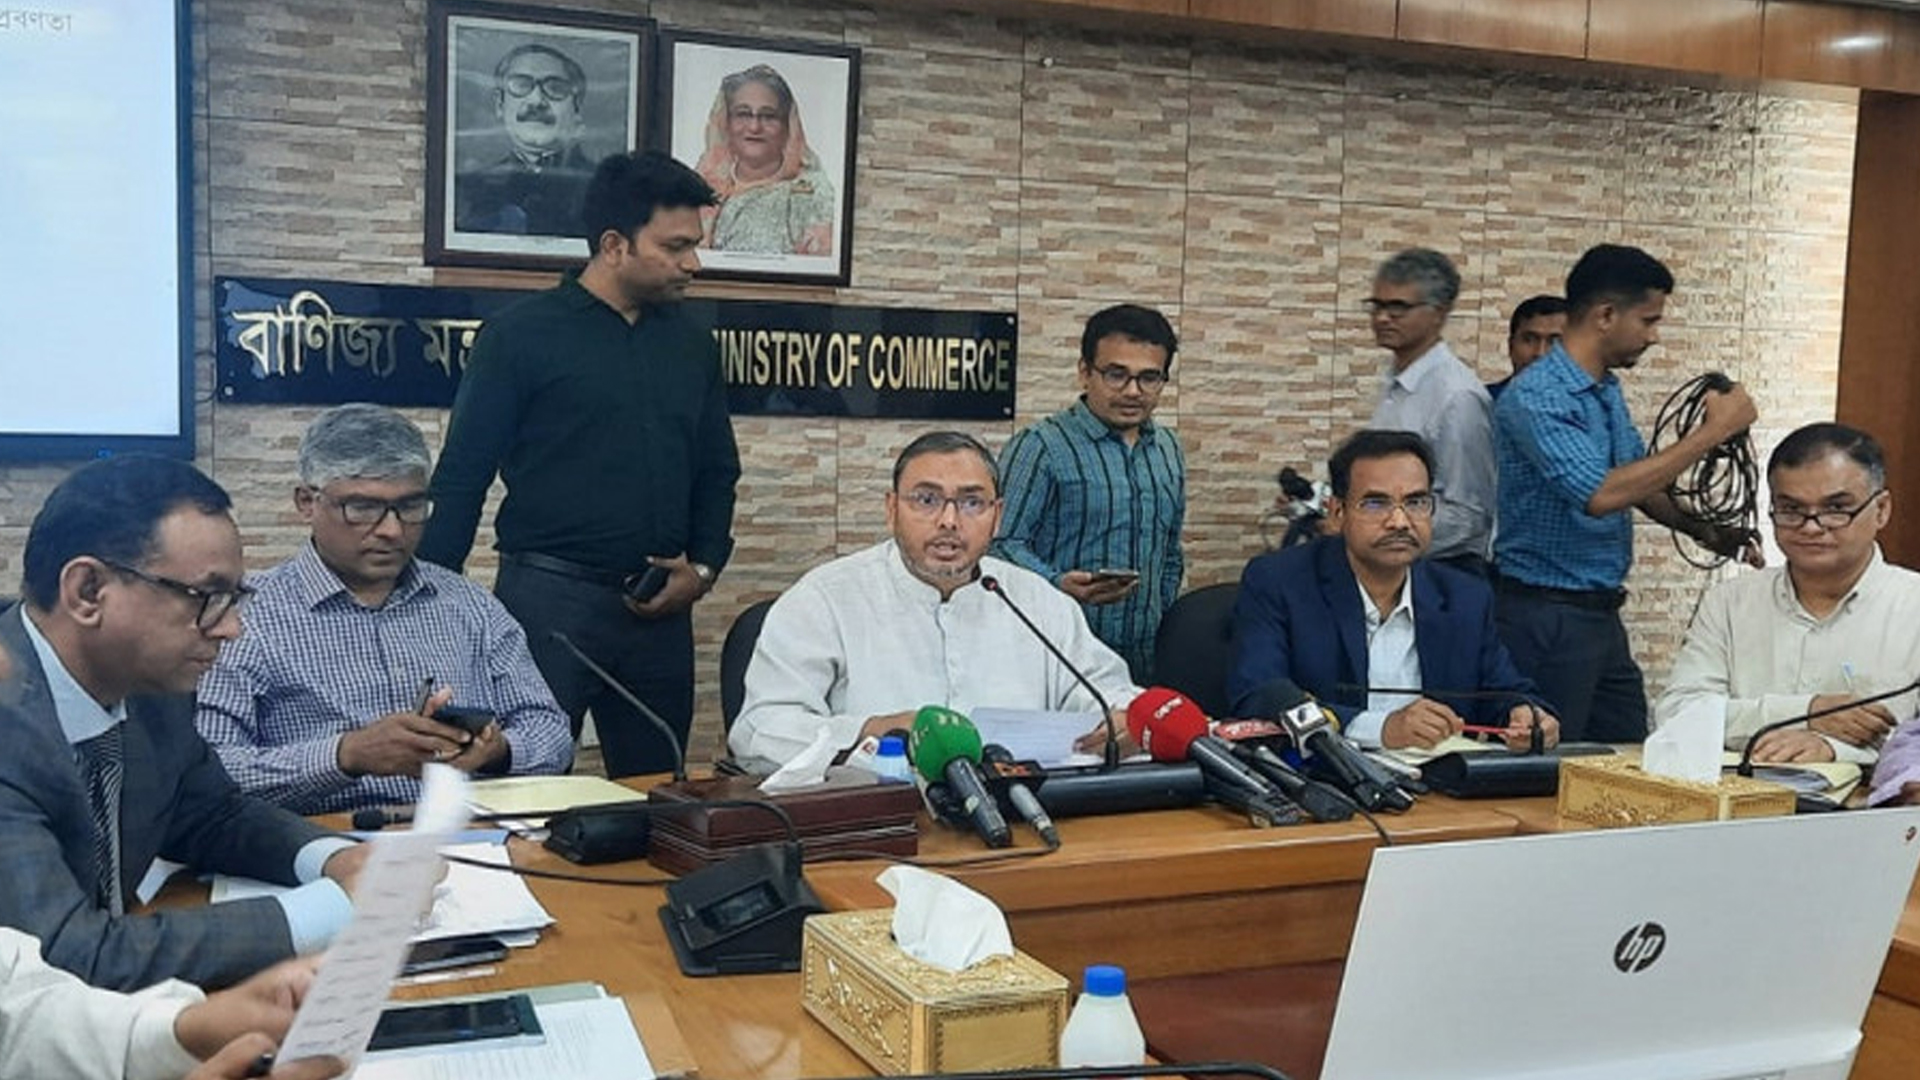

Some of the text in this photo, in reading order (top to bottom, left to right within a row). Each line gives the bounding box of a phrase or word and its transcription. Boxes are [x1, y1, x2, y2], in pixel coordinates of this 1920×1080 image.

[233, 291, 404, 377] বাণিজ্য
[712, 329, 1011, 392] INISTRY OF COMMERCE
[1614, 922, 1666, 973] hp
